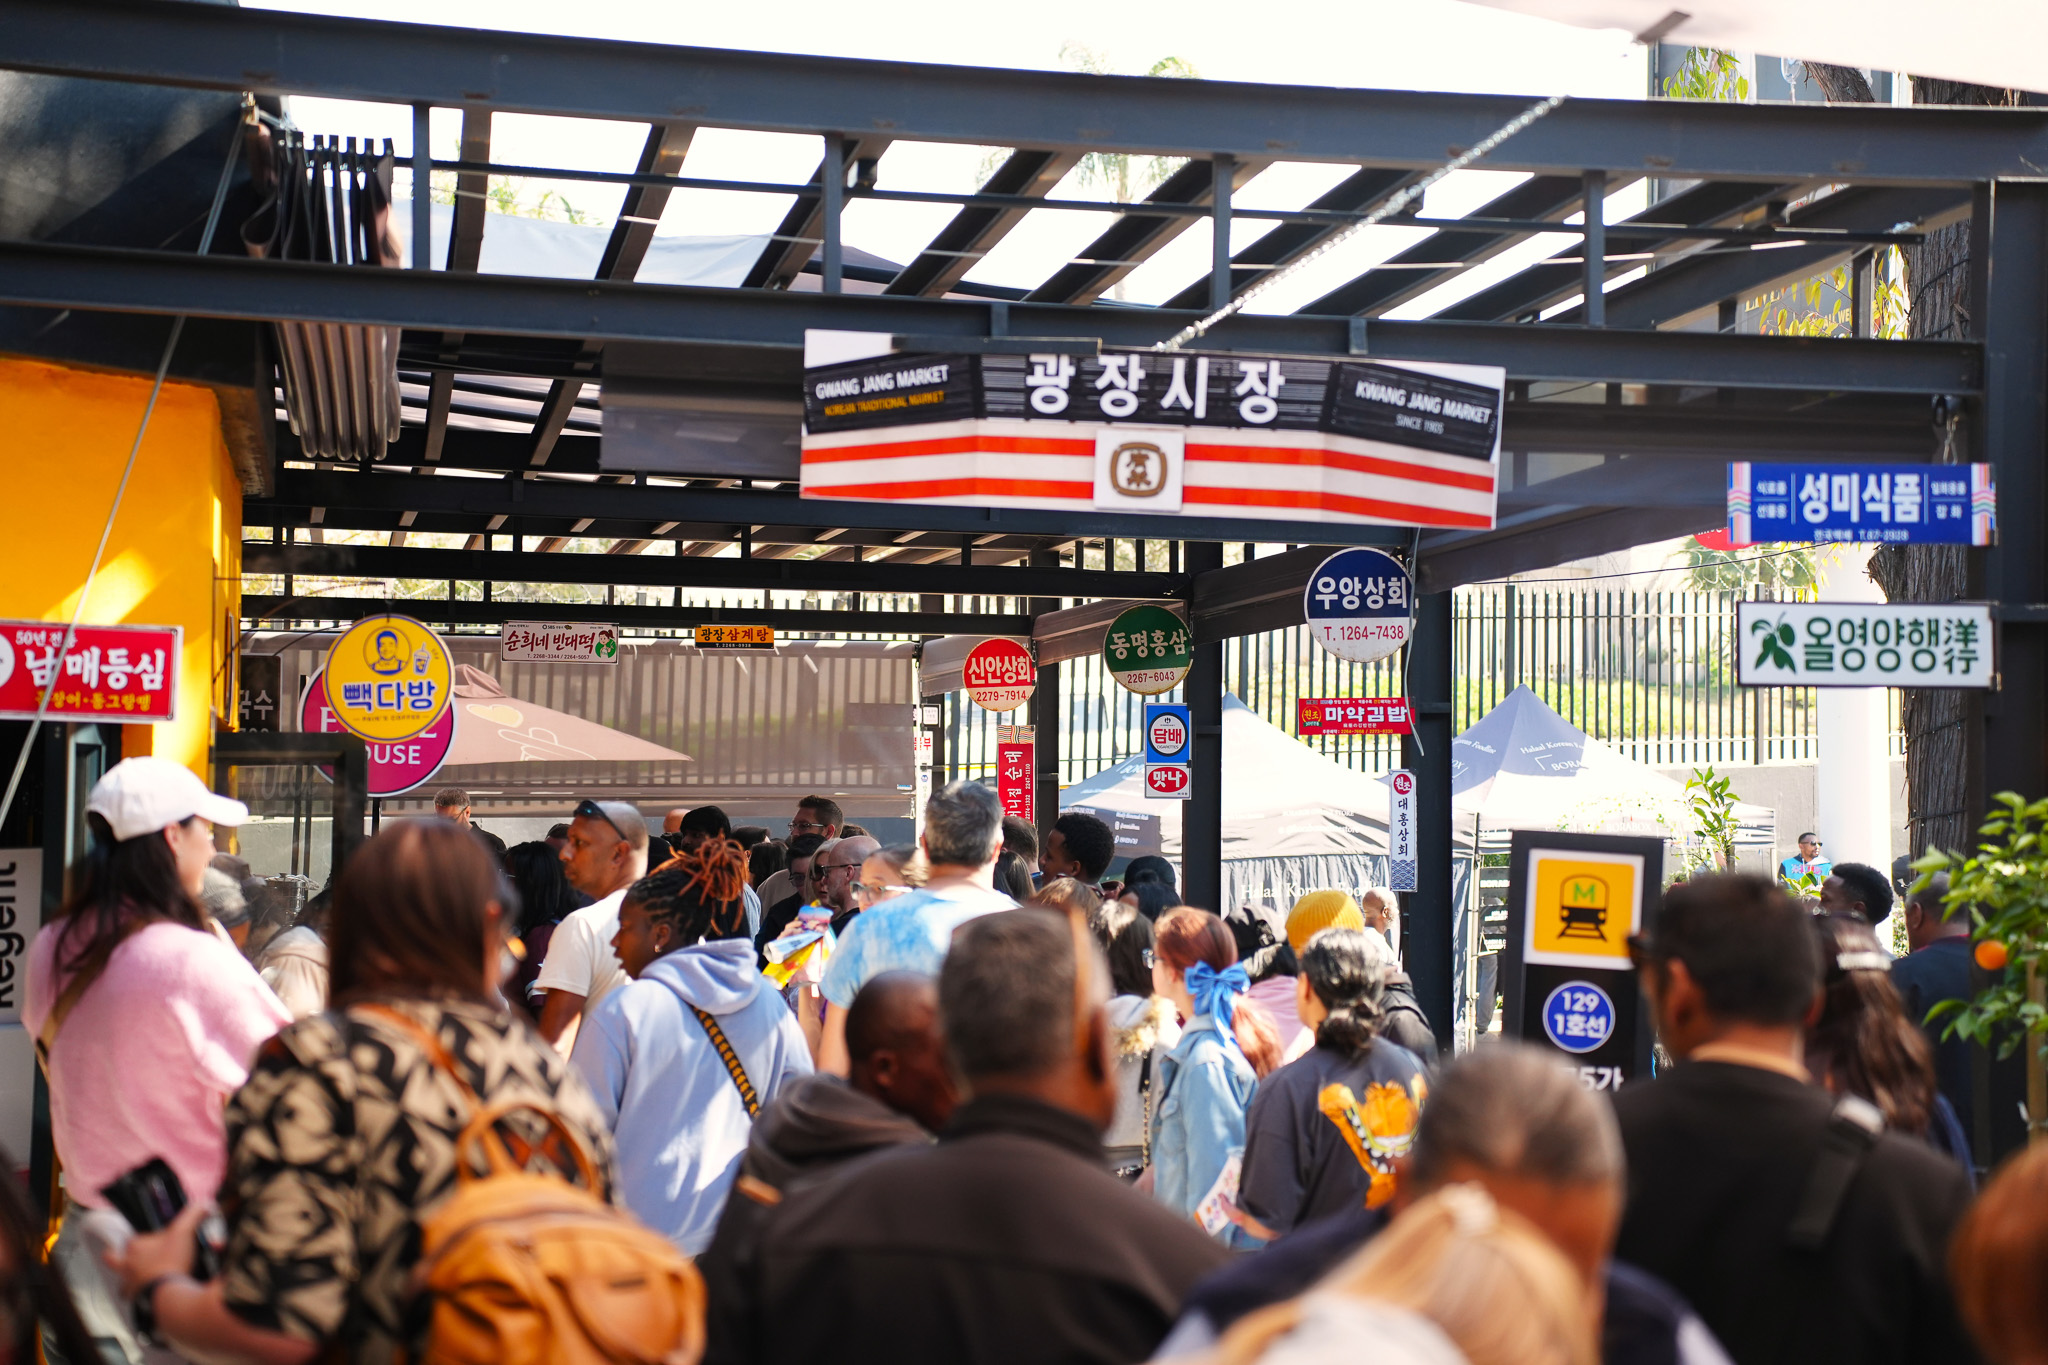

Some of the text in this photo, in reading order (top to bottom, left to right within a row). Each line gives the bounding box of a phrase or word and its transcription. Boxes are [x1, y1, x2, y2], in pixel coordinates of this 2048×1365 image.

[815, 364, 950, 400] GWANG JANG MARKET
[1025, 354, 1286, 424] 광장시장
[824, 390, 945, 416] KOREAN TRADITIONAL MARKET
[1355, 380, 1493, 425] KWANG JANG MARKET
[1395, 413, 1422, 431] SINCE
[1799, 472, 1922, 523] 성미식품
[1315, 576, 1407, 610] 우앙상회
[15, 630, 47, 647] 50년
[505, 630, 595, 654] 순희네 빈대떡
[1109, 628, 1187, 660] 동명홍삼
[1340, 625, 1404, 640] 1264-7438
[24, 646, 166, 691] 남매등심
[967, 655, 1031, 684] 신안상회
[1127, 671, 1175, 684] 2267-6043
[343, 680, 437, 713] 빽다방
[976, 690, 1027, 702] 2279-7914
[1325, 706, 1407, 722] 마약김밥
[1154, 728, 1182, 744] 담배
[1520, 743, 1546, 754] Halaal
[1003, 750, 1024, 782] 순대
[1153, 769, 1183, 788] 맛나
[1395, 776, 1412, 791] 원조
[1397, 797, 1409, 857] 대홍상회
[1241, 884, 1280, 900] Halaal
[1573, 881, 1596, 903] M
[1561, 991, 1600, 1013] 129
[1554, 1014, 1607, 1038] 1호선
[1561, 1066, 1624, 1093] 5가
